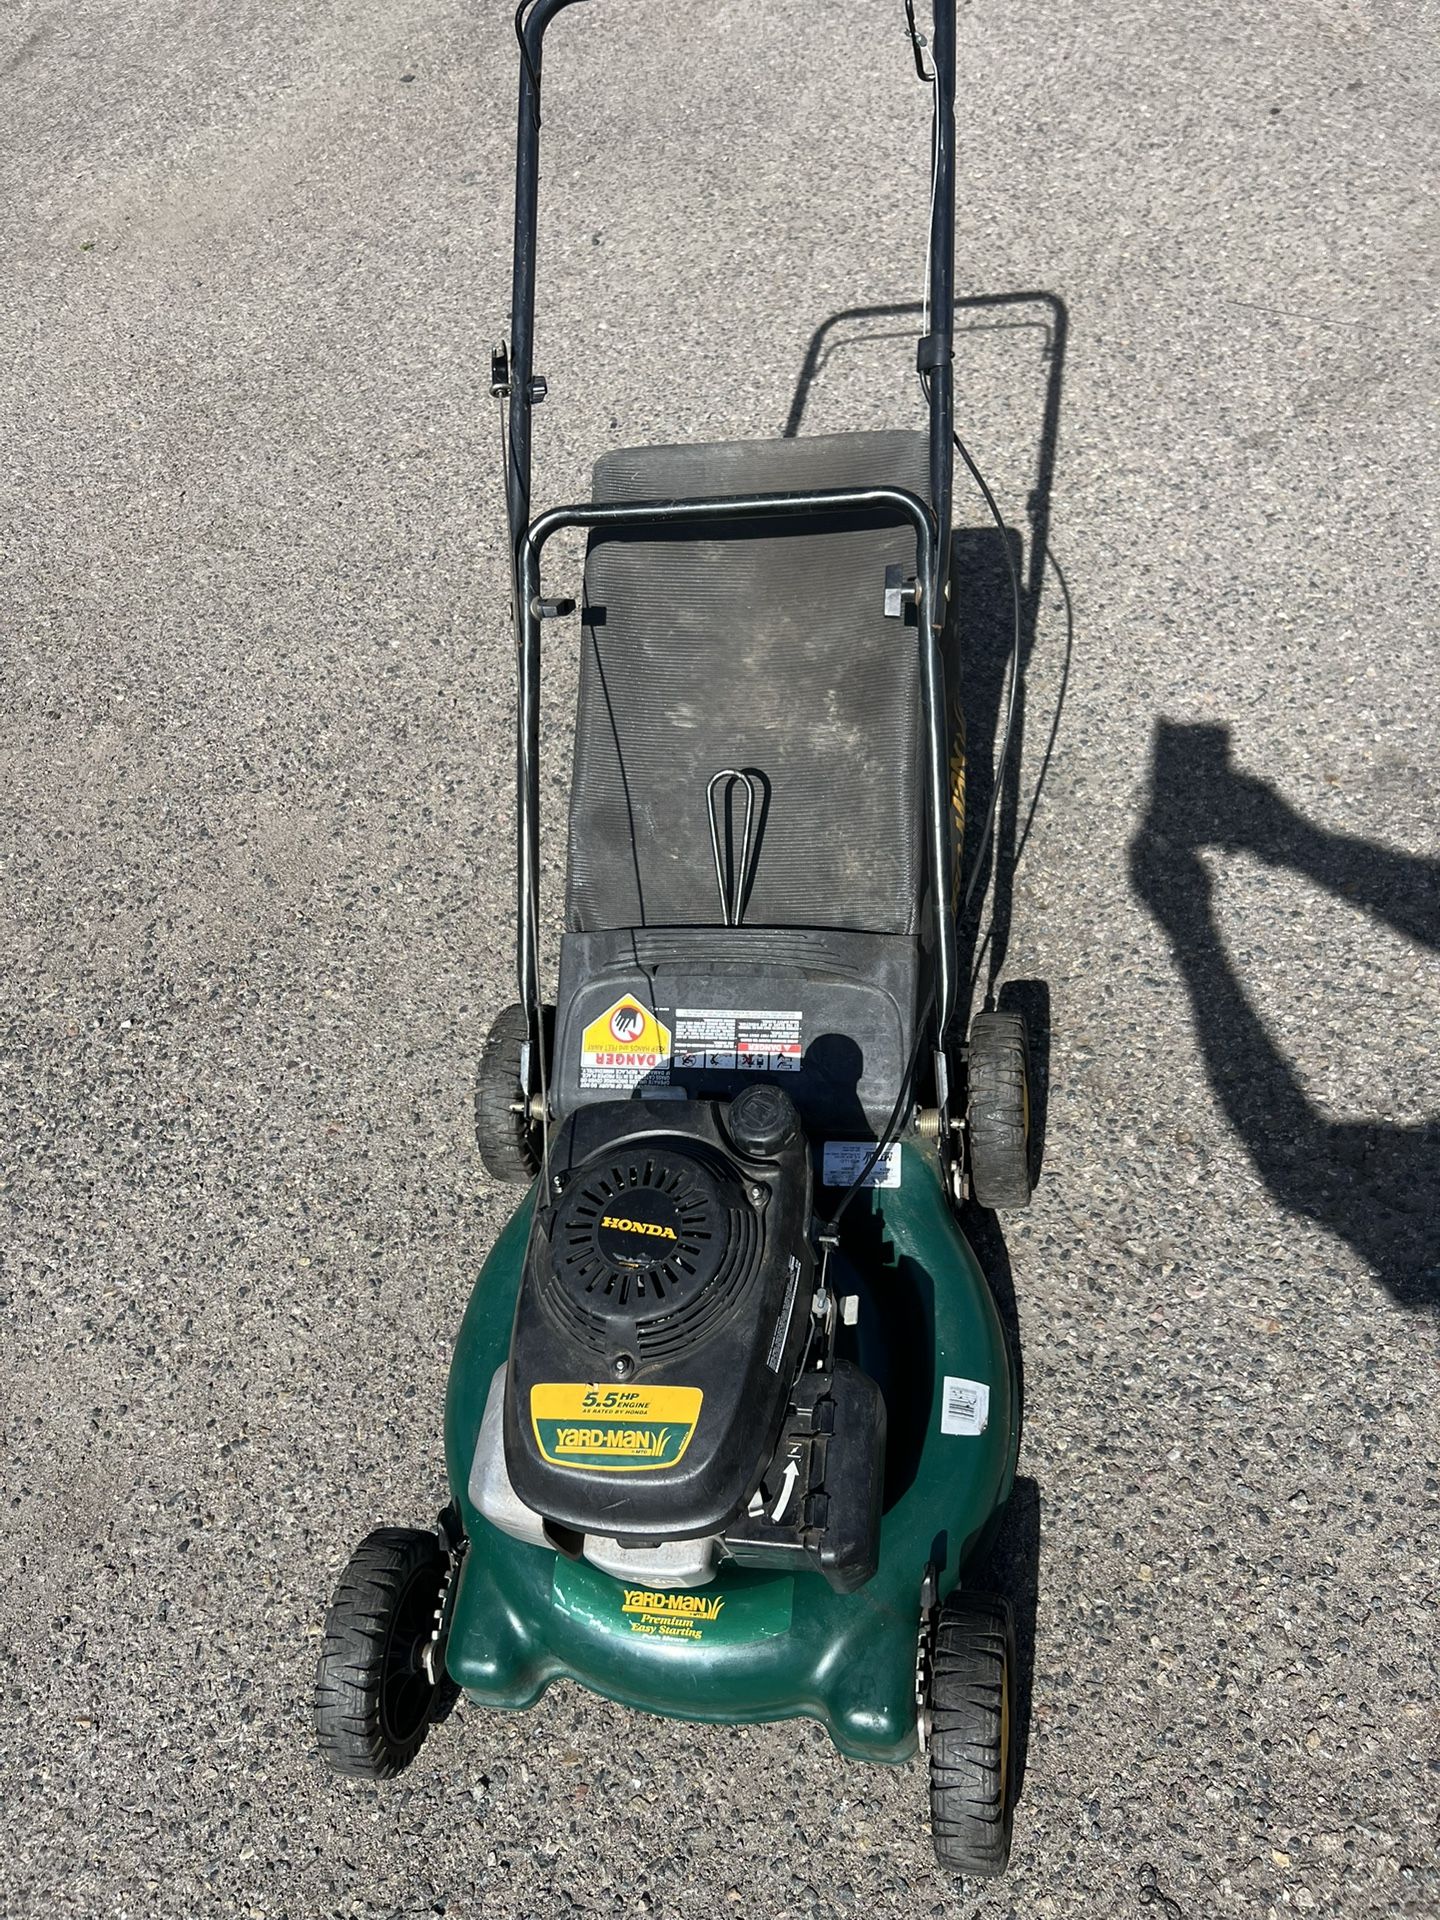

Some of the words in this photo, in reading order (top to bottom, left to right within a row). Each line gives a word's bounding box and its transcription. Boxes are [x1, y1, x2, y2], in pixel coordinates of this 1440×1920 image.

[595, 1053, 657, 1066] DANGER
[601, 1216, 677, 1240] HONDA
[582, 1392, 620, 1408] 5.5
[641, 1614, 694, 1628] Premium
[631, 1622, 656, 1634] Easy
[658, 1625, 703, 1639] Starting
